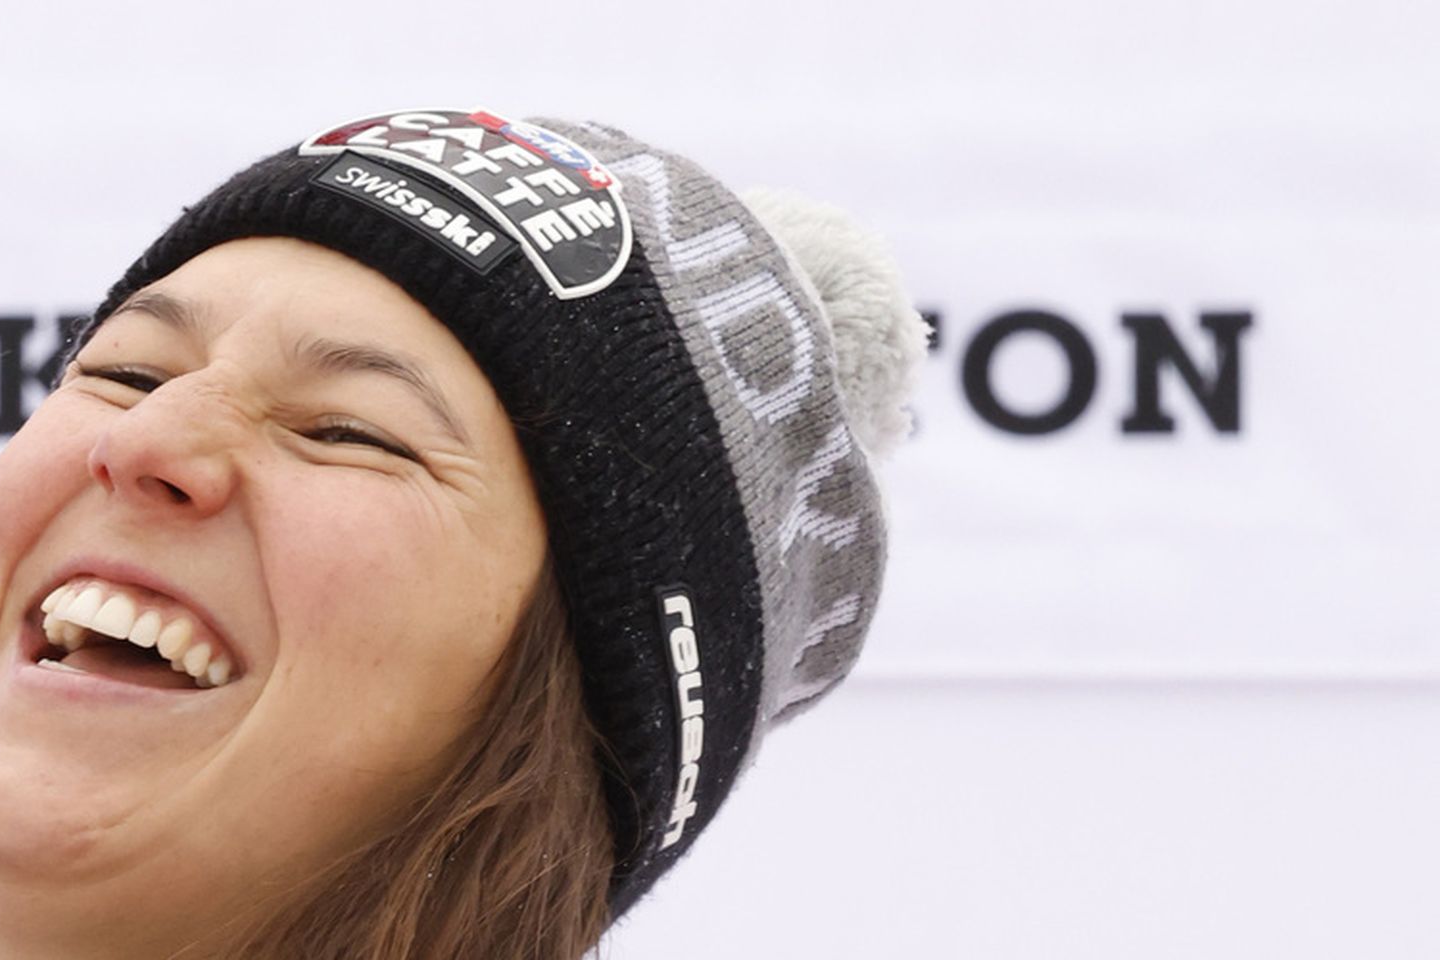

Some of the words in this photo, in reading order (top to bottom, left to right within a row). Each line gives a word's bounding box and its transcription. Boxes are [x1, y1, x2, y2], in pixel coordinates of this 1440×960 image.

[335, 166, 496, 257] swissski
[347, 125, 579, 252] LATTE
[921, 310, 1254, 435] ON
